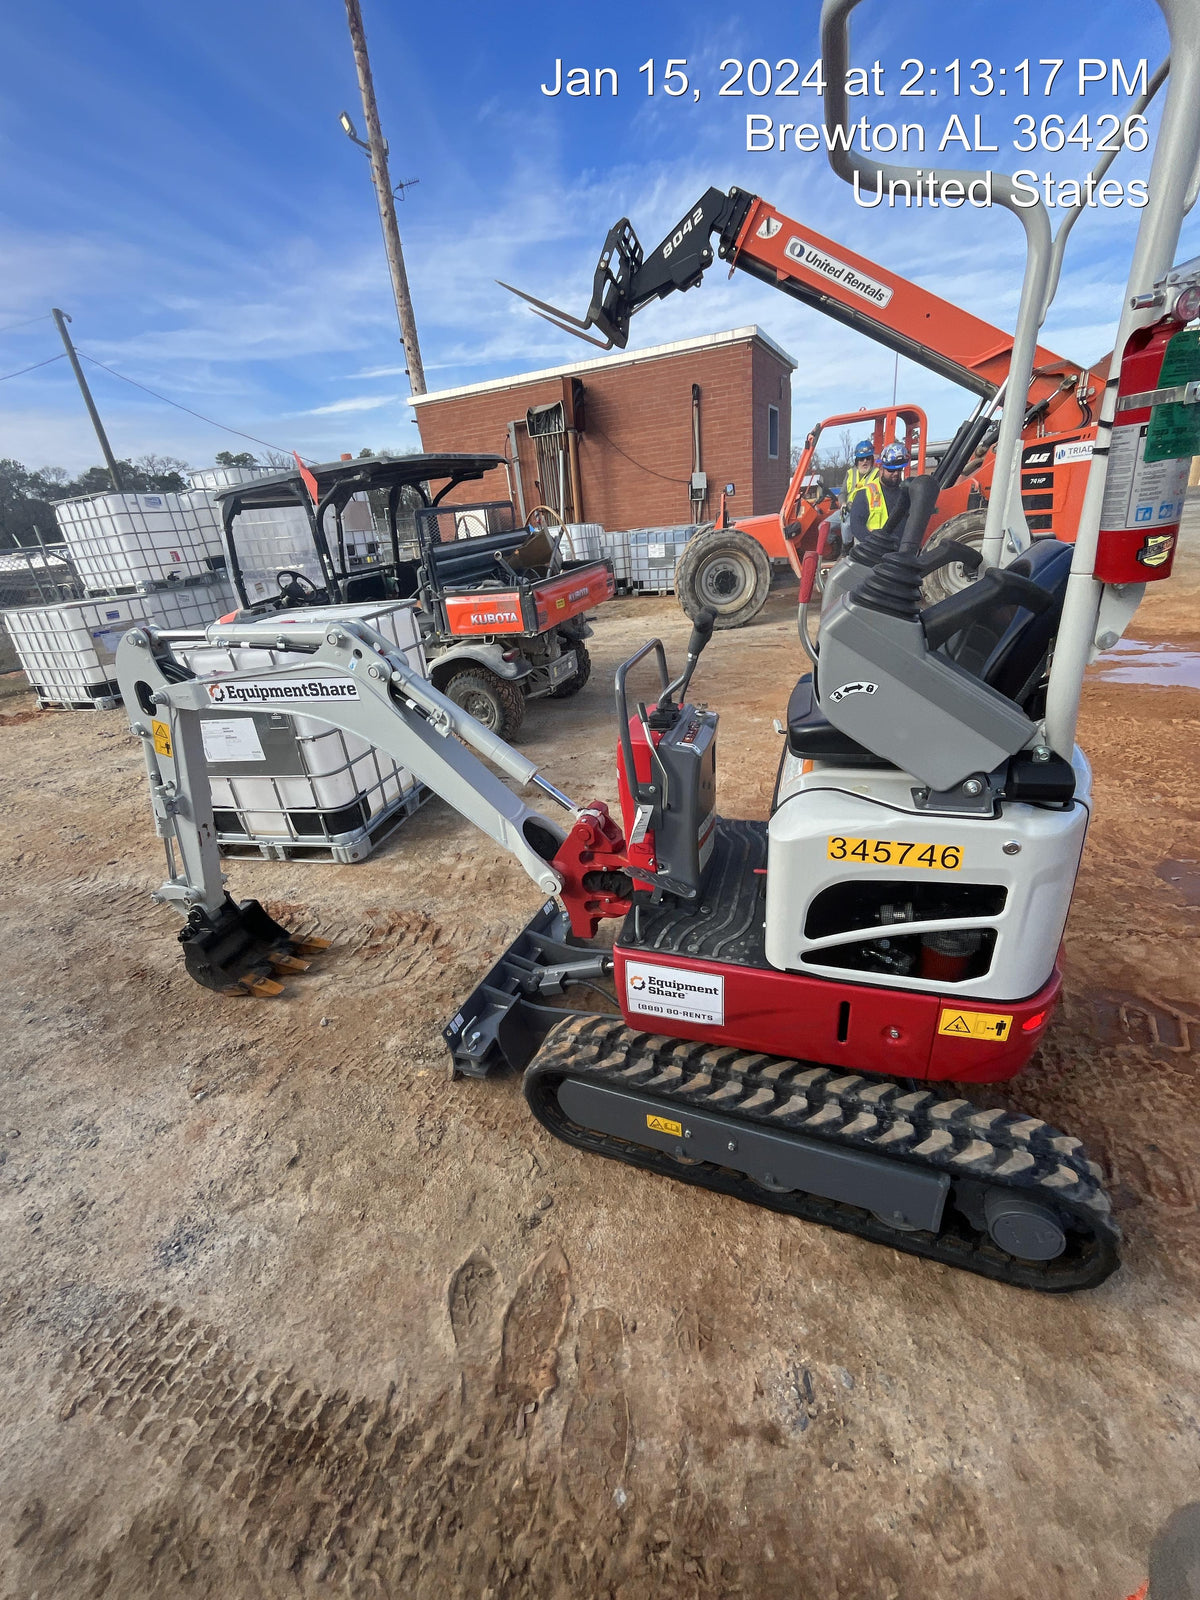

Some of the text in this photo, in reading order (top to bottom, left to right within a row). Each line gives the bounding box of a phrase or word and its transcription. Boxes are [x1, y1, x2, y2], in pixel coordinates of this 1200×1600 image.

[662, 207, 704, 259] 8042
[805, 250, 885, 302] United Rentals
[1025, 452, 1051, 464] JLG
[470, 612, 519, 626] KUBOTA
[225, 682, 357, 701] EquipmentShare
[829, 836, 961, 870] 345746
[648, 975, 719, 996] Equipment
[648, 986, 686, 999] Share
[637, 1003, 664, 1014] (888)
